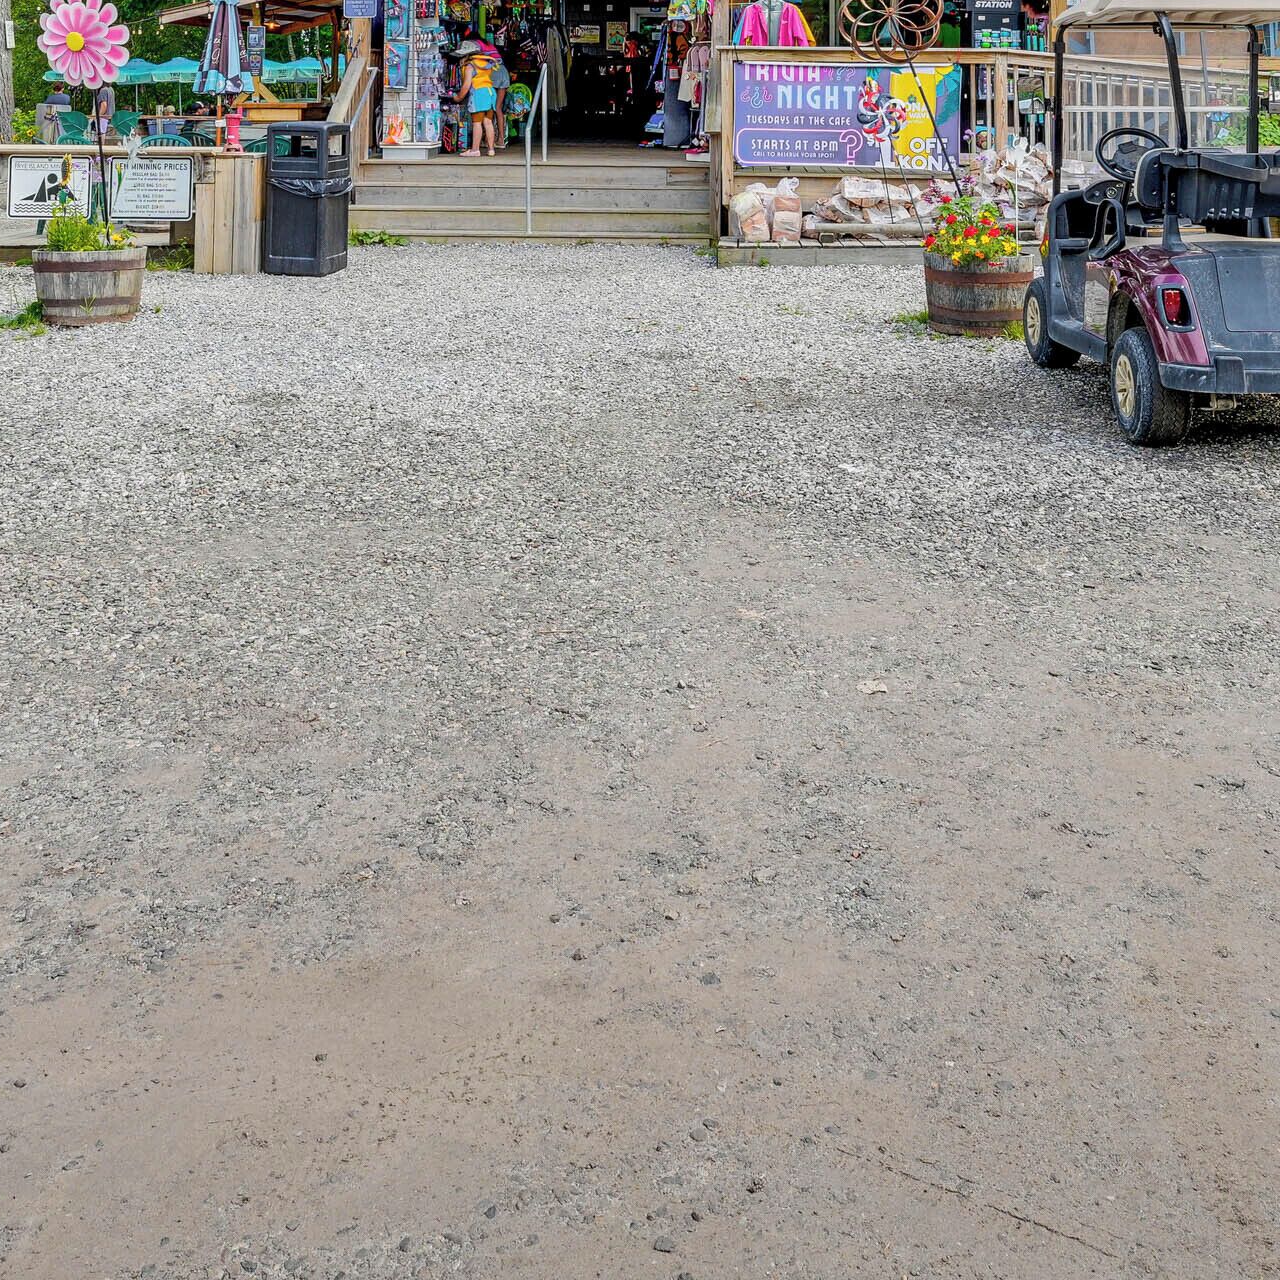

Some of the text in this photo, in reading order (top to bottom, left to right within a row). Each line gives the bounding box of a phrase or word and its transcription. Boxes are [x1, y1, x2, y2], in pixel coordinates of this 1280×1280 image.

[974, 1, 1013, 9] STATION
[777, 84, 857, 110] NIGHT
[746, 114, 851, 126] TUESDAYS AT THE CAFE
[751, 138, 839, 152] STARTS AT 8PM
[909, 136, 948, 154] OFF
[163, 163, 188, 171] PRICES
[898, 154, 957, 171] KONA
